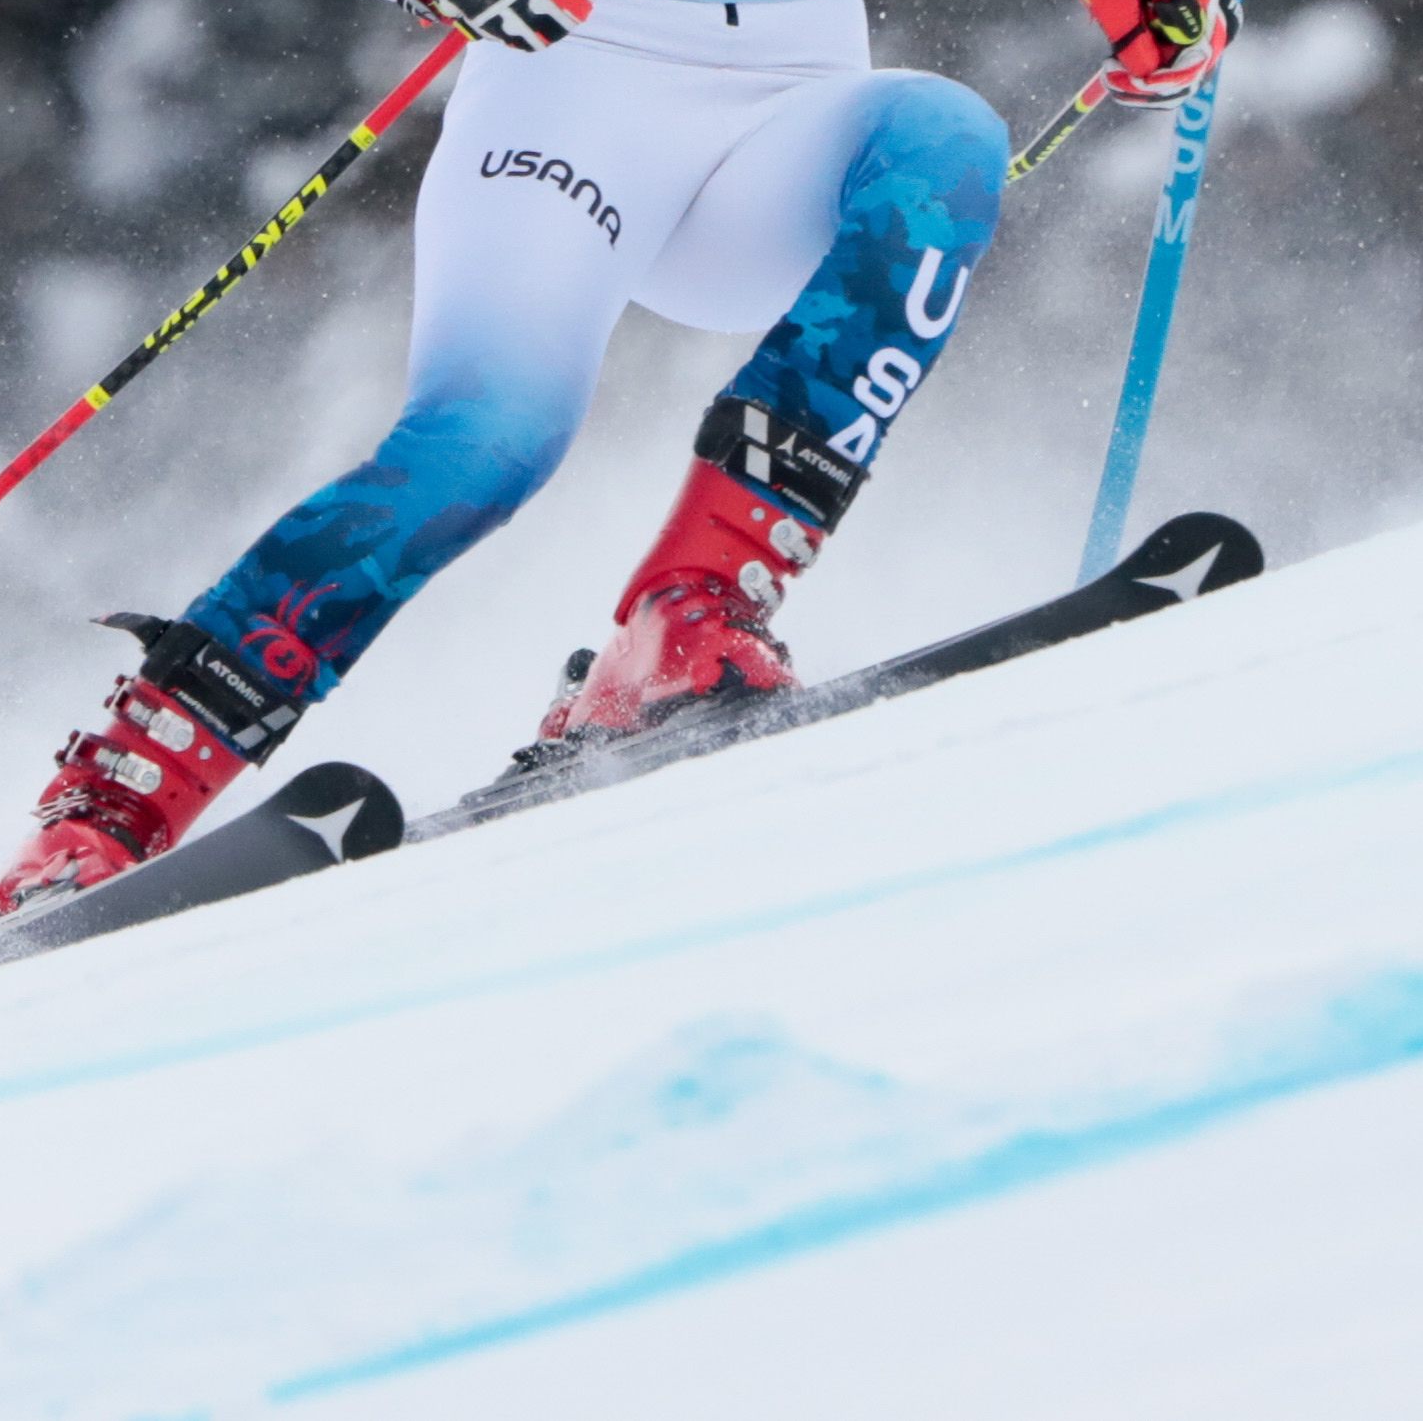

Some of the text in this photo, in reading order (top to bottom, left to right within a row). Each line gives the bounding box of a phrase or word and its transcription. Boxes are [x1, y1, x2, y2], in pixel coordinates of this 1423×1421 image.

[240, 173, 328, 270] LEKI
[480, 149, 622, 251] USANA
[826, 246, 969, 465] USA
[207, 659, 266, 708] ATOMIC
